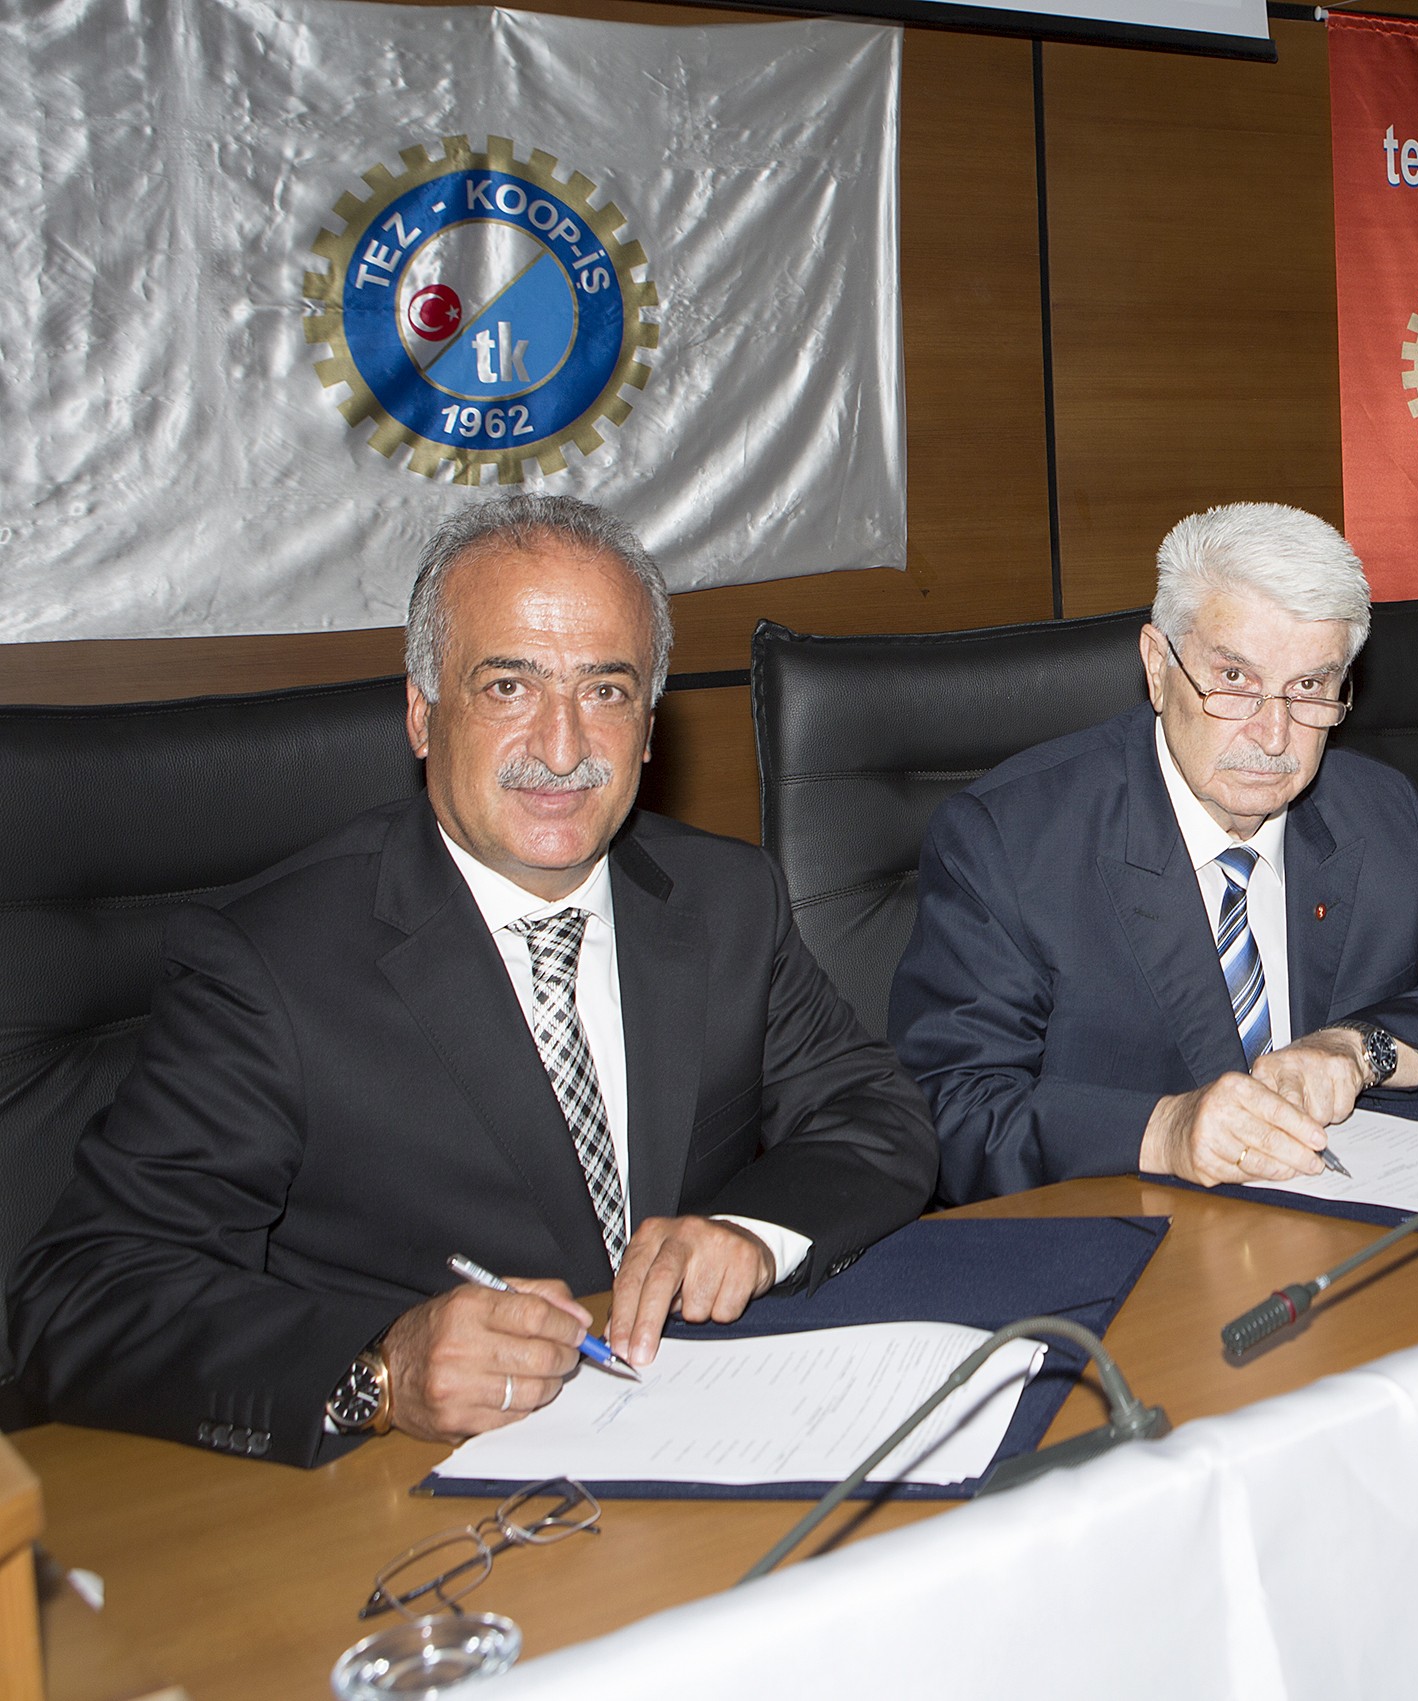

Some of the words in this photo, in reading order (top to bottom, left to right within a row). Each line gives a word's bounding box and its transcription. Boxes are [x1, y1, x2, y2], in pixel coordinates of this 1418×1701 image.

[355, 212, 422, 290] TEZ
[465, 179, 611, 296] KOOP-İŞ
[471, 321, 531, 384] tk
[441, 404, 534, 438] 1962
